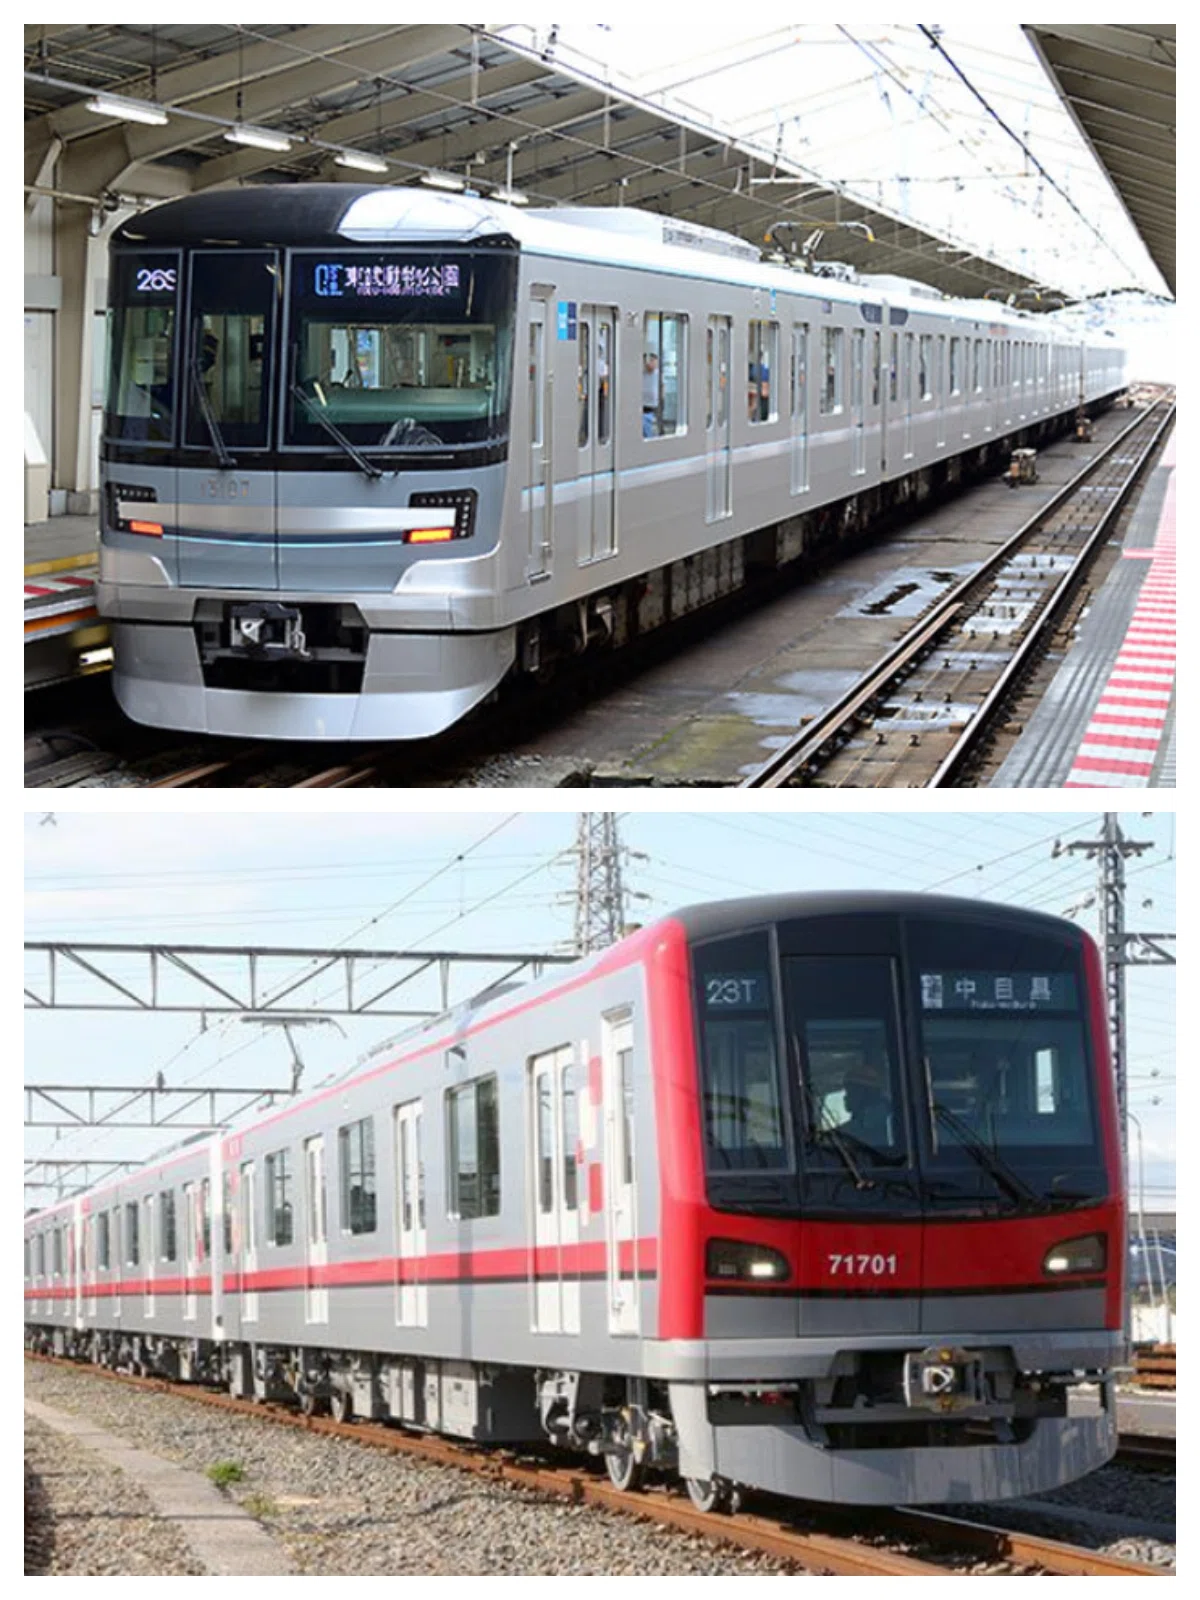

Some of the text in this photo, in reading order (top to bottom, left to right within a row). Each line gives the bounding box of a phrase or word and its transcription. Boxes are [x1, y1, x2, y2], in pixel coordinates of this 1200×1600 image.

[136, 269, 177, 290] 26S
[707, 979, 757, 1004] 23T
[828, 1254, 897, 1274] 71701
